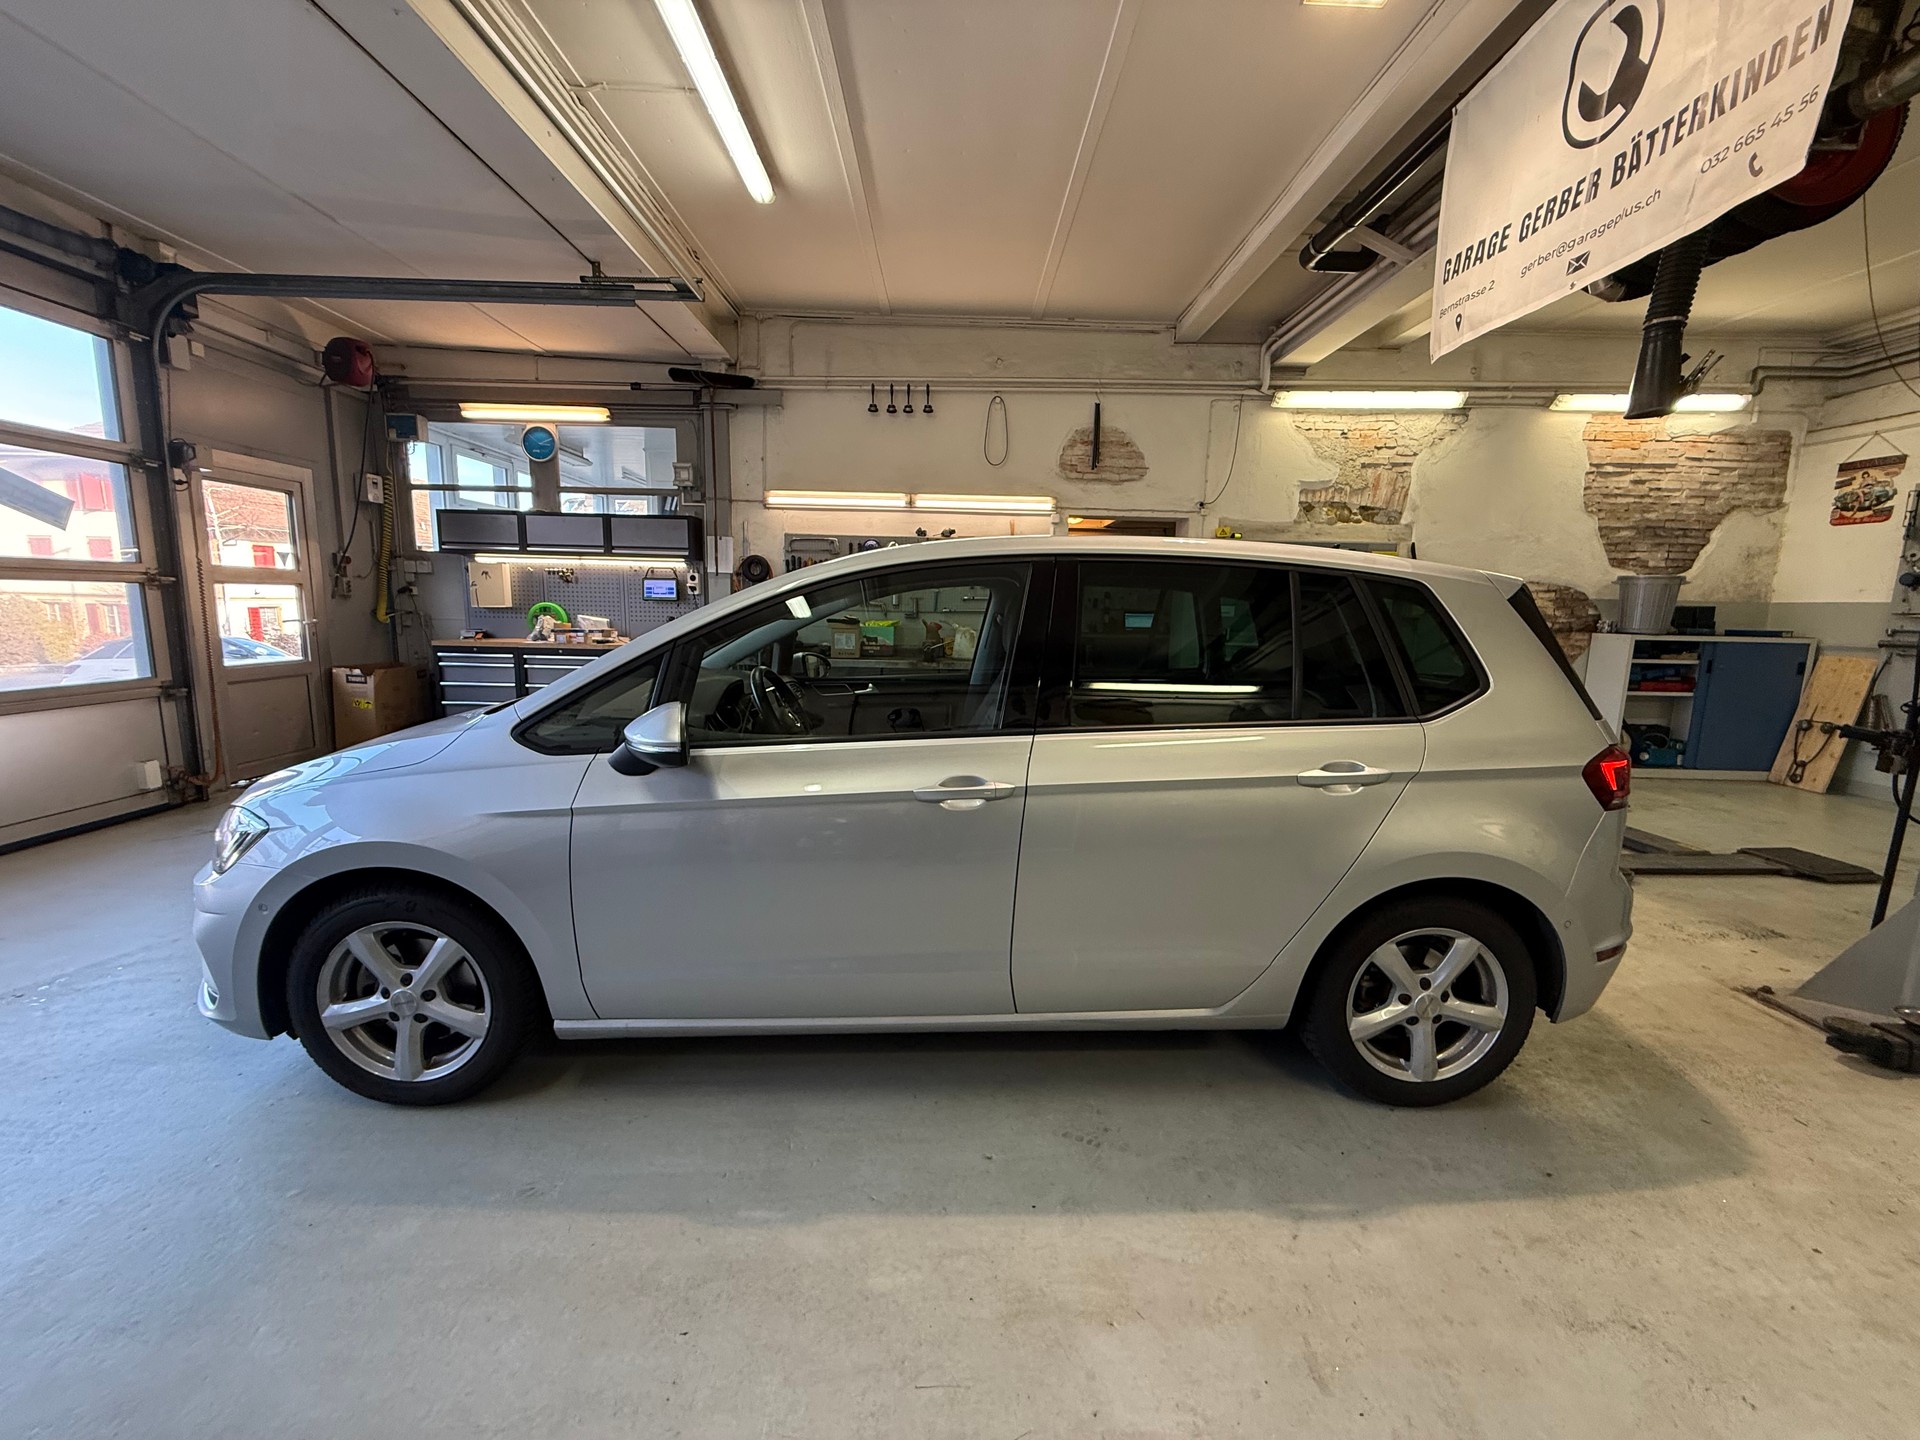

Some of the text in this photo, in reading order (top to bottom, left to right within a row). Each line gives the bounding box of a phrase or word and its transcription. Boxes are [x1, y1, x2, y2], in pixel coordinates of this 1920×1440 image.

[1442, 0, 1834, 286] GARAGE GERBER BÄTTERKINDEN
[1700, 84, 1820, 174] 032 665 45 56
[1520, 188, 1661, 278] gerber@garageplus.ch
[1440, 279, 1496, 319] Bernstrasse 2
